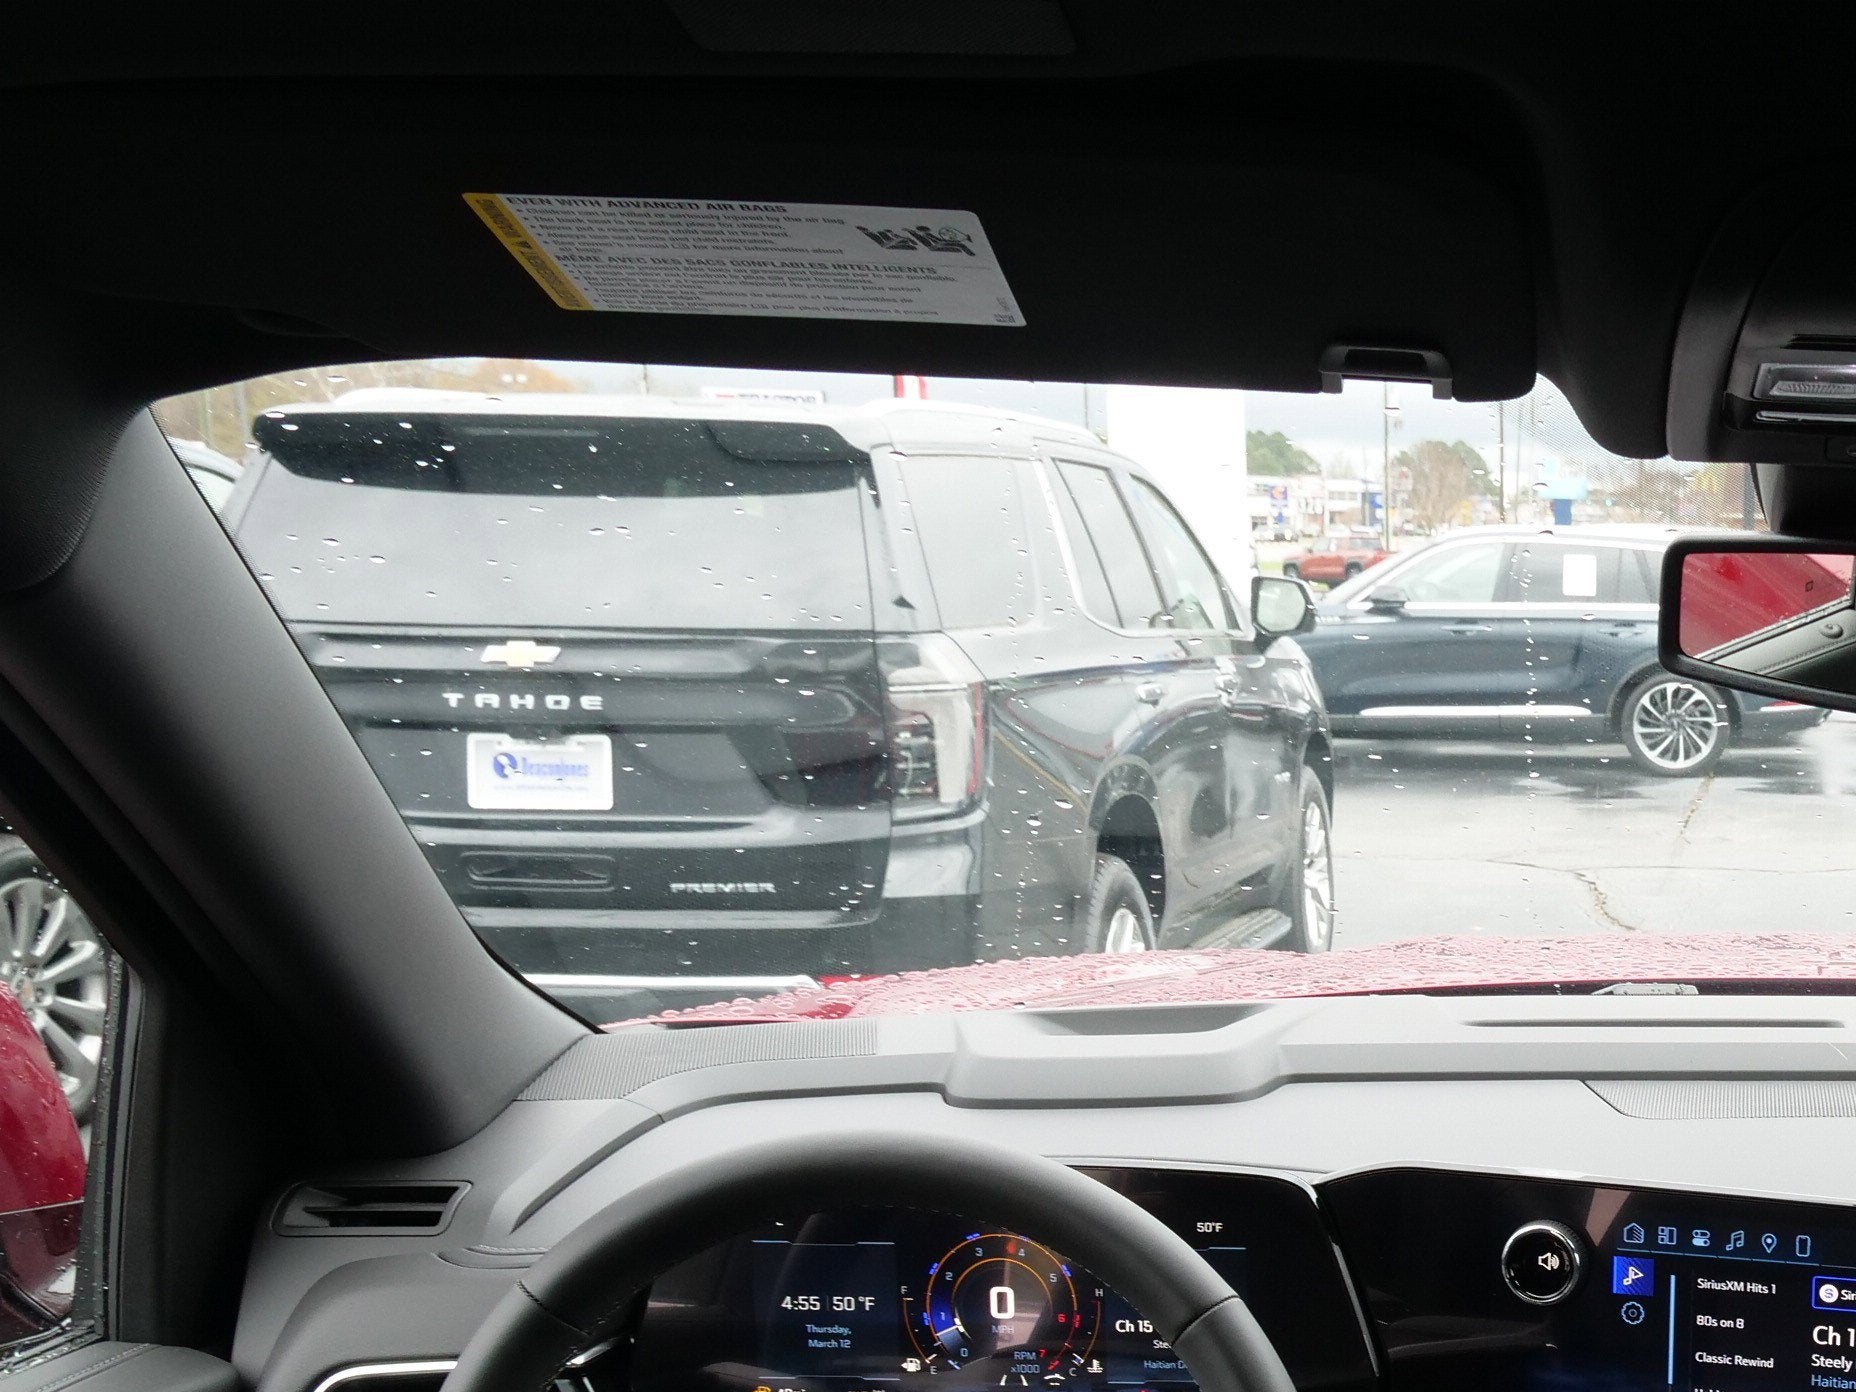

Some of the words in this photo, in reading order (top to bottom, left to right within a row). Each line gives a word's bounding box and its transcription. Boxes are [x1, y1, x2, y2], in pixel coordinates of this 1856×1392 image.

[506, 196, 551, 206] EVEN
[553, 198, 602, 208] WITH
[607, 200, 701, 210] ADVANCED
[706, 202, 736, 212] AIR
[739, 204, 788, 214] BAGS
[442, 692, 604, 710] TAHOE
[670, 882, 777, 894] PREMIER
[975, 1247, 983, 1257] 3
[1018, 1249, 1026, 1258] 4
[945, 1271, 953, 1281] 2
[1096, 1288, 1104, 1297] H
[1697, 1278, 1745, 1293] SiriusXM
[1746, 1282, 1769, 1294] Hits
[781, 1295, 821, 1311] 4:55
[832, 1296, 856, 1311] 50
[989, 1285, 1015, 1320] 0
[1115, 1319, 1135, 1333] Ch
[1137, 1320, 1154, 1333] 15
[1696, 1314, 1719, 1328] 80s
[1719, 1318, 1735, 1329] on
[1735, 1317, 1745, 1329] 8
[806, 1323, 852, 1336] Thursday,
[1812, 1325, 1841, 1347] Ch
[808, 1338, 837, 1349] March
[839, 1338, 851, 1349] 12
[1153, 1339, 1172, 1349] Ste
[960, 1348, 969, 1358] 0
[1013, 1351, 1037, 1361] RPM
[1143, 1360, 1176, 1370] Haitian
[1695, 1351, 1732, 1367] Classic
[1733, 1355, 1774, 1369] Rewind
[1811, 1353, 1853, 1373] Steely
[1011, 1364, 1040, 1374] x1000
[1811, 1374, 1856, 1391] Haitian
